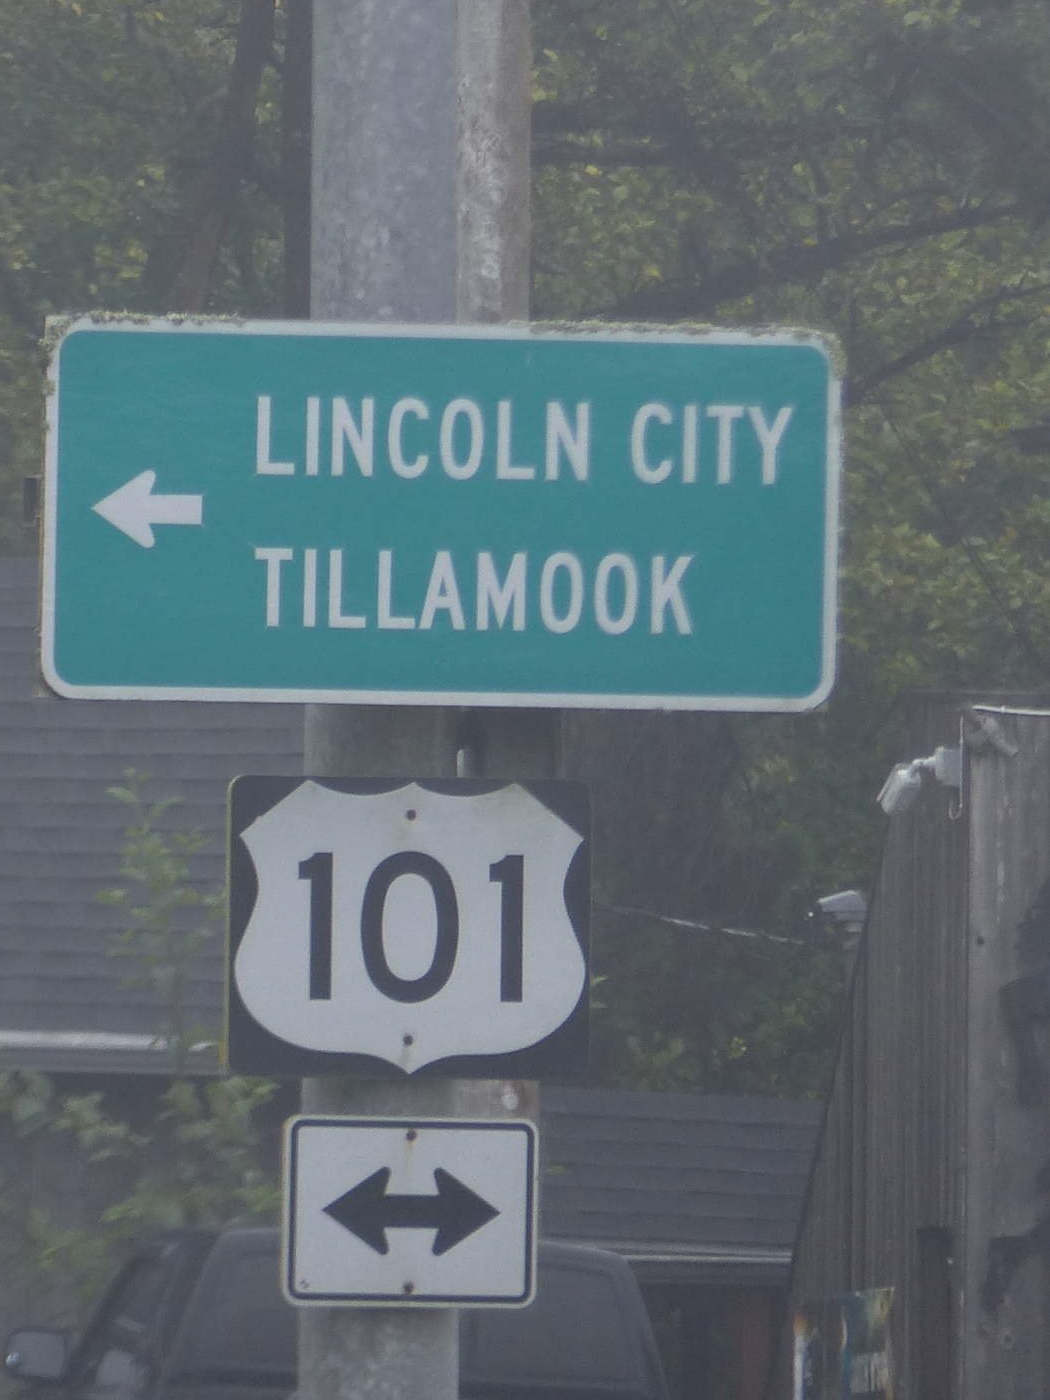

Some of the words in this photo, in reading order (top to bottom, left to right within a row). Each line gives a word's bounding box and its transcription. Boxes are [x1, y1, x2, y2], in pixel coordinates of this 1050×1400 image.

[255, 395, 591, 482] LINCOLN
[630, 402, 794, 485] CITY
[254, 547, 694, 636] TILLAMOOK
[297, 850, 525, 1004] 101
